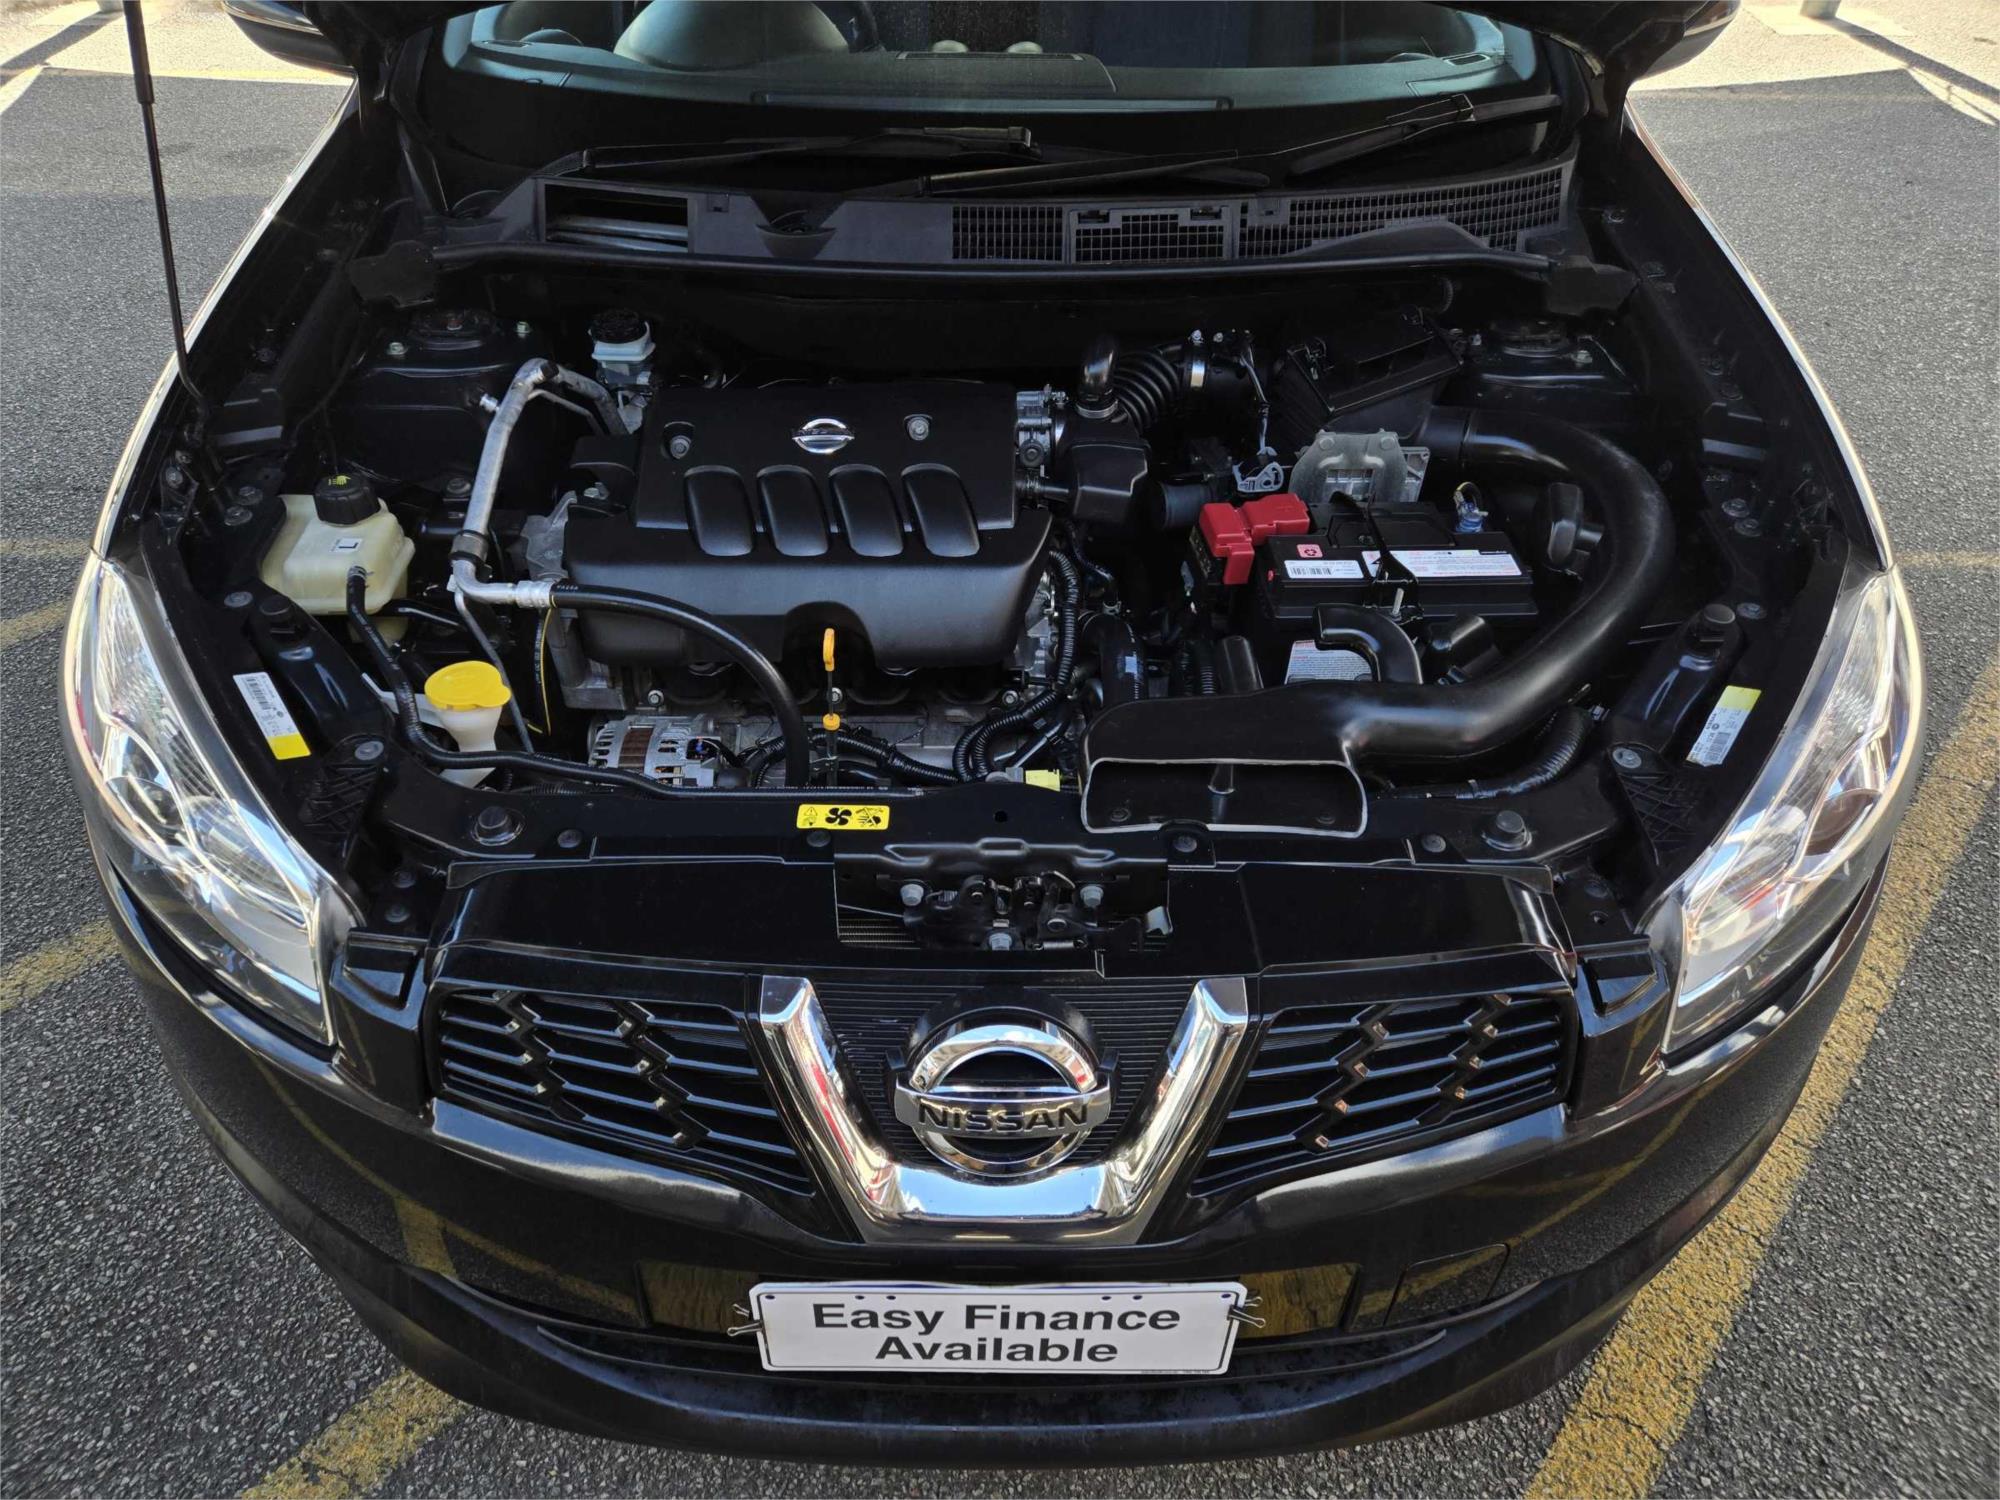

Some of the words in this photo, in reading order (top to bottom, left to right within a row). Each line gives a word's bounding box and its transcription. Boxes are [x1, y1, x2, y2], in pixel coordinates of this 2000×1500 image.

[918, 1101, 1088, 1132] NISSAN
[812, 1303, 944, 1335] Easy
[965, 1304, 1181, 1330] Finance
[875, 1336, 1118, 1362] Available
